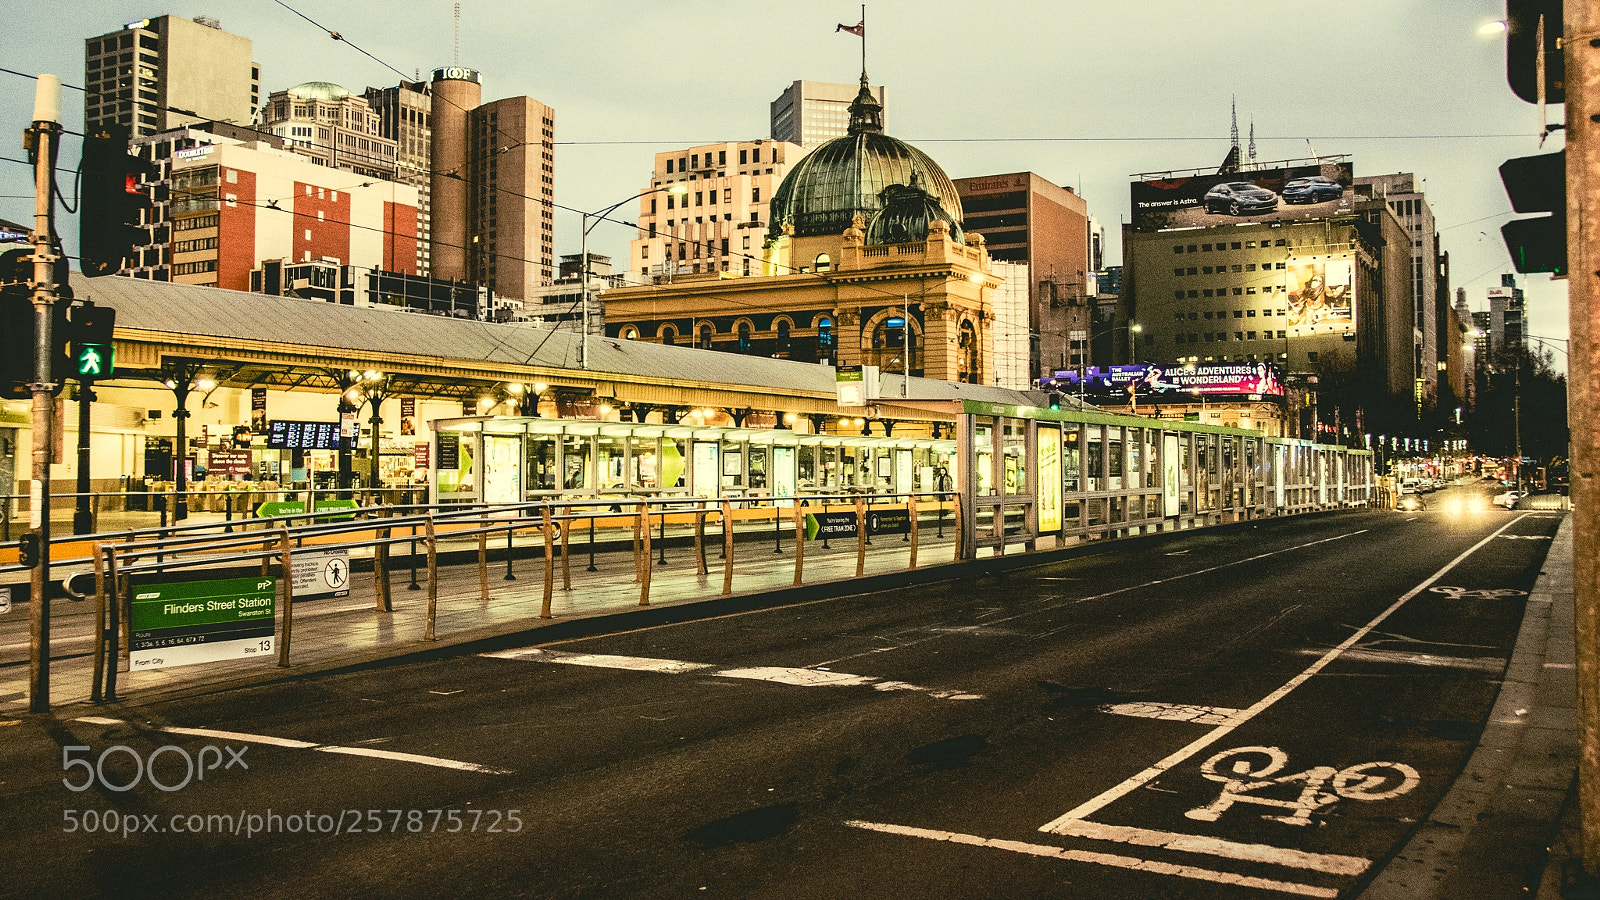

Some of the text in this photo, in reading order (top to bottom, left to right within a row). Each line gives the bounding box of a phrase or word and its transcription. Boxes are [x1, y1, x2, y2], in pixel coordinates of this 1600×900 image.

[442, 68, 470, 78] IOOF
[970, 181, 1008, 191] Emirates
[1165, 366, 1251, 376] ALICE'S ADVENTURES
[164, 597, 271, 614] Flinders Street Station
[259, 640, 270, 651] 13
